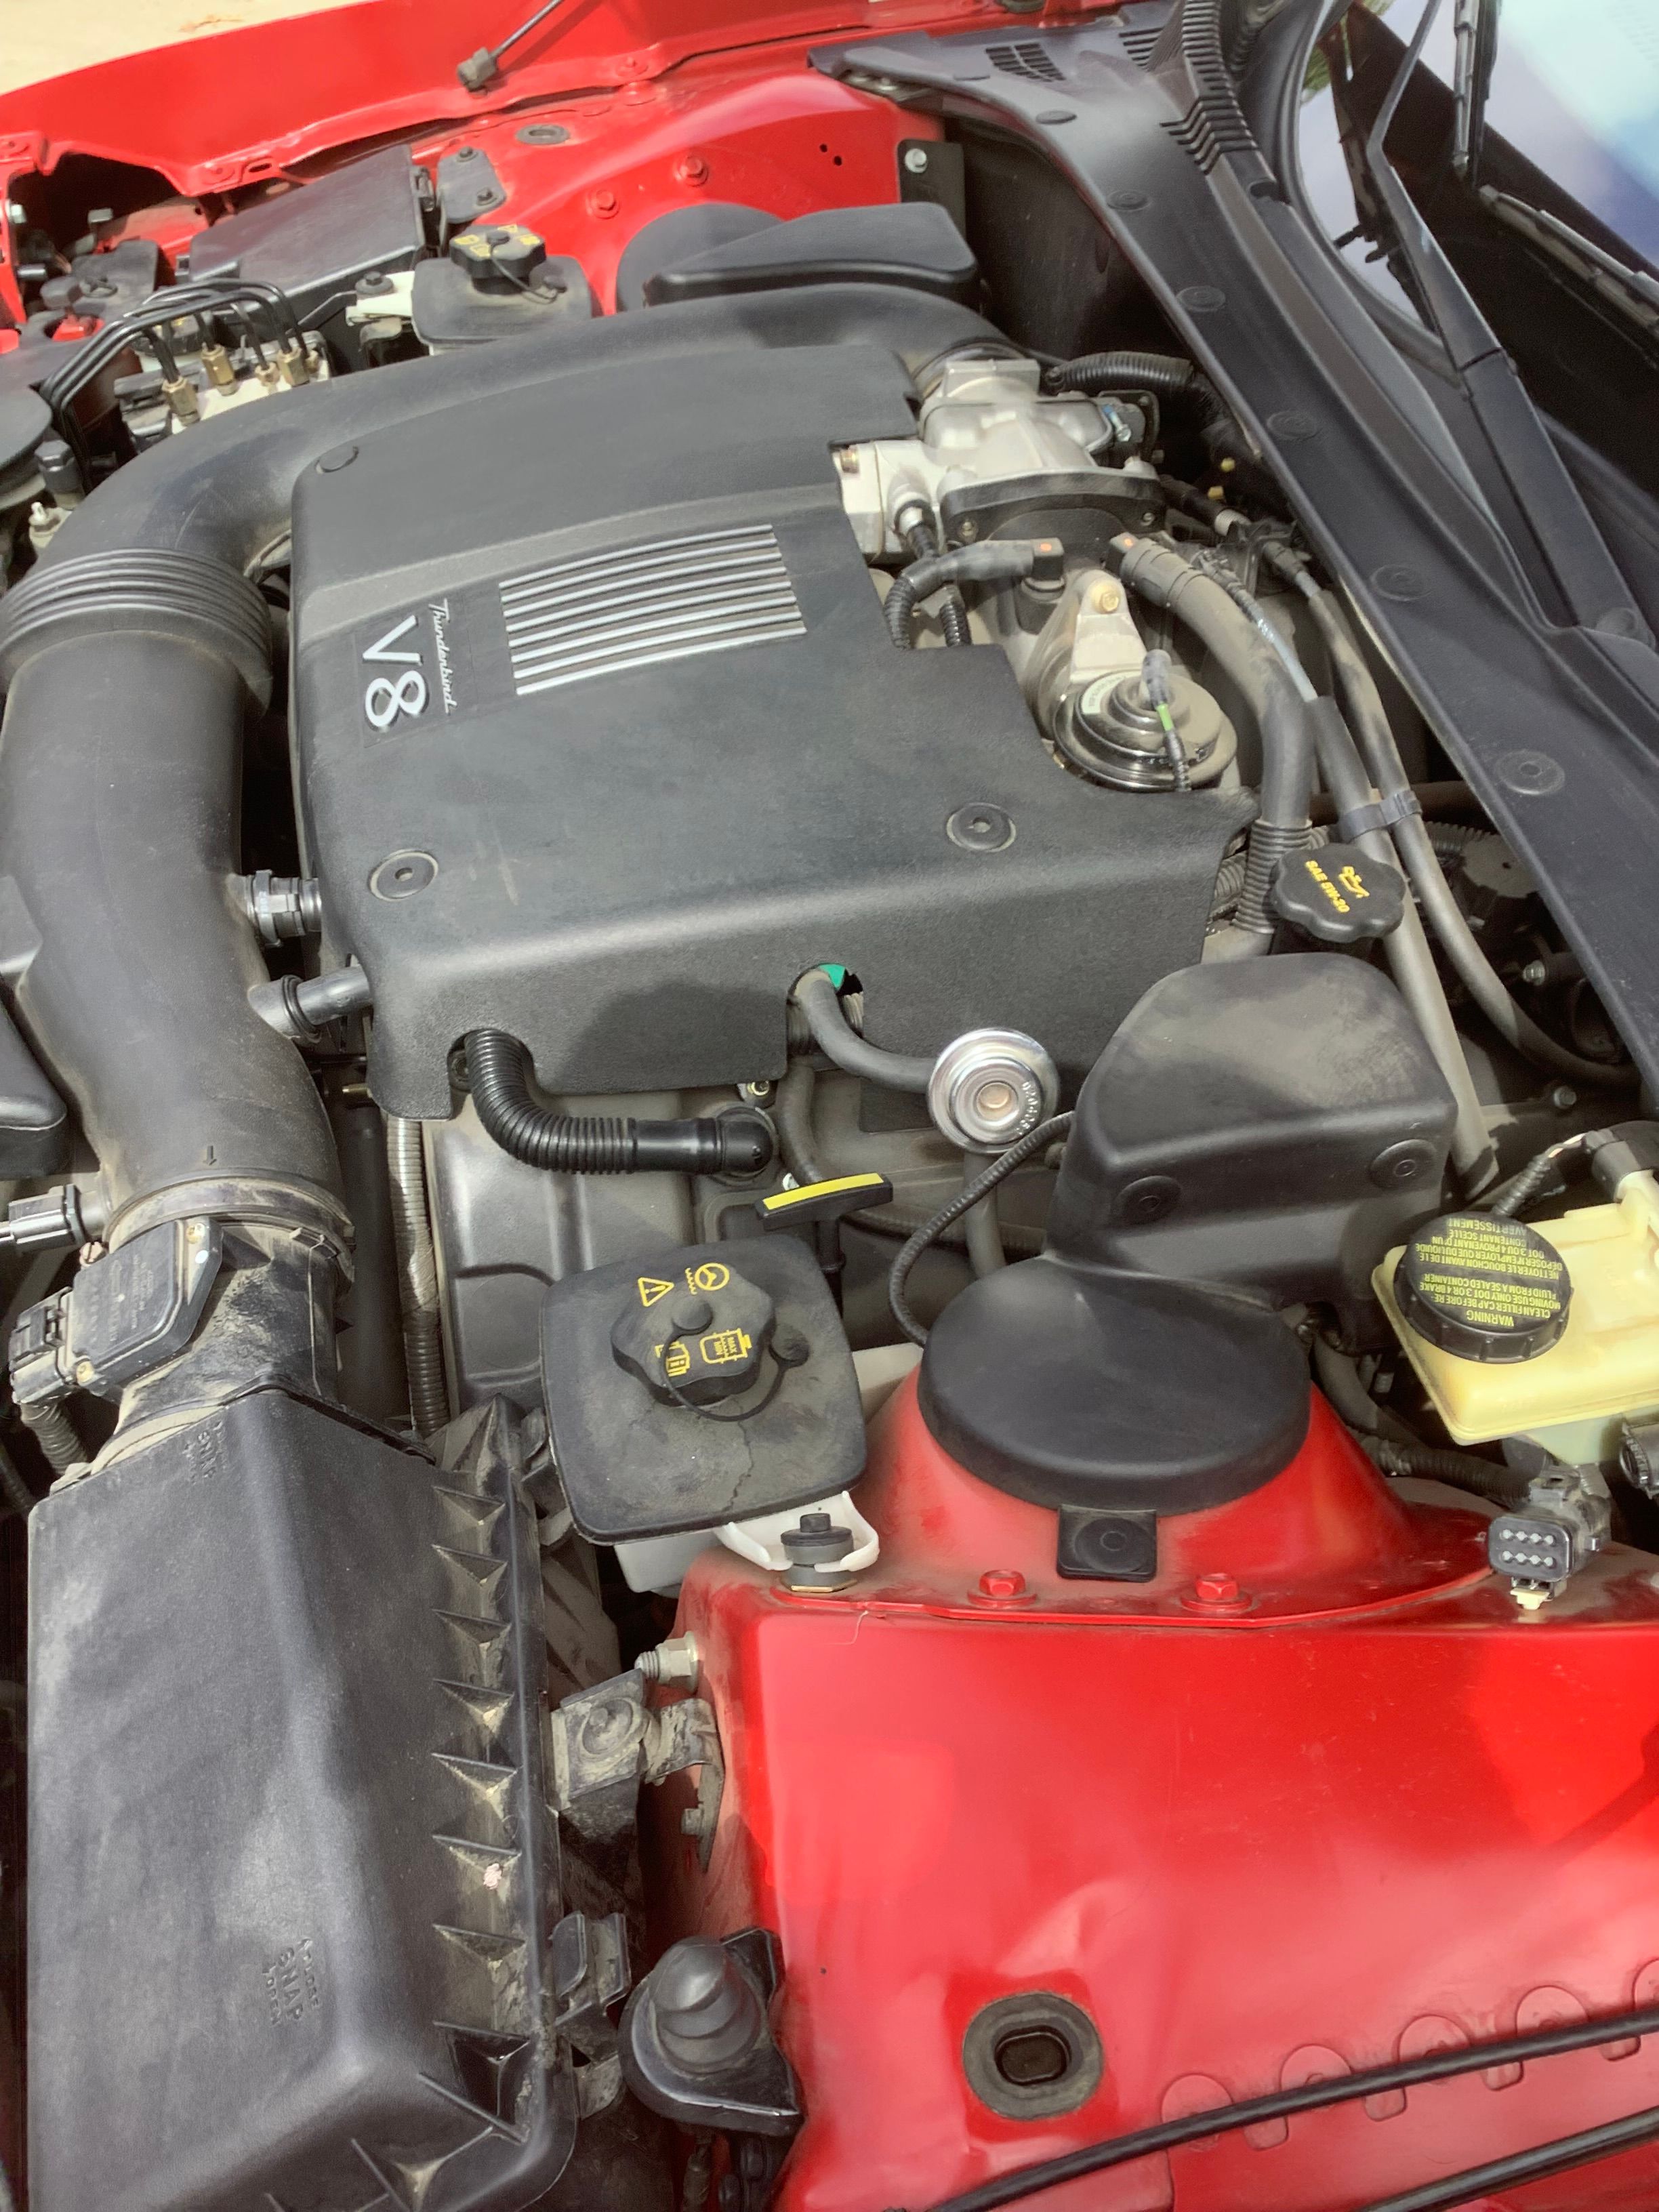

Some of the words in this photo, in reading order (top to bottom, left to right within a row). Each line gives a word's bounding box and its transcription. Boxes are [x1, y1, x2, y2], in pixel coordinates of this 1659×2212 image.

[428, 597, 459, 715] Thunderbird
[362, 614, 428, 728] V8
[1305, 860, 1328, 882] SAE
[1321, 882, 1351, 913] 5W-20
[1452, 1239, 1500, 1252] PROVENANT
[1479, 1234, 1526, 1247] CONTENANT
[1502, 1245, 1506, 1253] 4
[1507, 1246, 1519, 1254] OU
[1529, 1250, 1544, 1258] DOT
[1420, 1253, 1429, 1262] LE
[1431, 1254, 1440, 1264] DE
[1466, 1259, 1506, 1272] BOUCHON
[1507, 1265, 1517, 1273] LE
[1518, 1265, 1558, 1279] NETTOYER
[1425, 1273, 1469, 1288] CONTAINER
[1471, 1279, 1501, 1292] SEALED
[1420, 1282, 1446, 1294] BRAKE
[1447, 1287, 1452, 1295] 4
[1452, 1287, 1465, 1296] OR
[1466, 1288, 1472, 1297] 3
[1502, 1284, 1508, 1293] A
[1509, 1285, 1532, 1296] FROM
[1473, 1290, 1490, 1300] DOT
[1492, 1292, 1511, 1303] ONLY
[1512, 1294, 1529, 1305] USE
[1532, 1289, 1556, 1299] FLUID
[1443, 1296, 1477, 1307] BEFORE
[1475, 1300, 1495, 1311] CAP
[1496, 1302, 1522, 1315] FILLER
[1523, 1304, 1551, 1318] CLEAN
[1467, 1310, 1514, 1326] WARNING
[278, 1947, 304, 2021] SNAP
